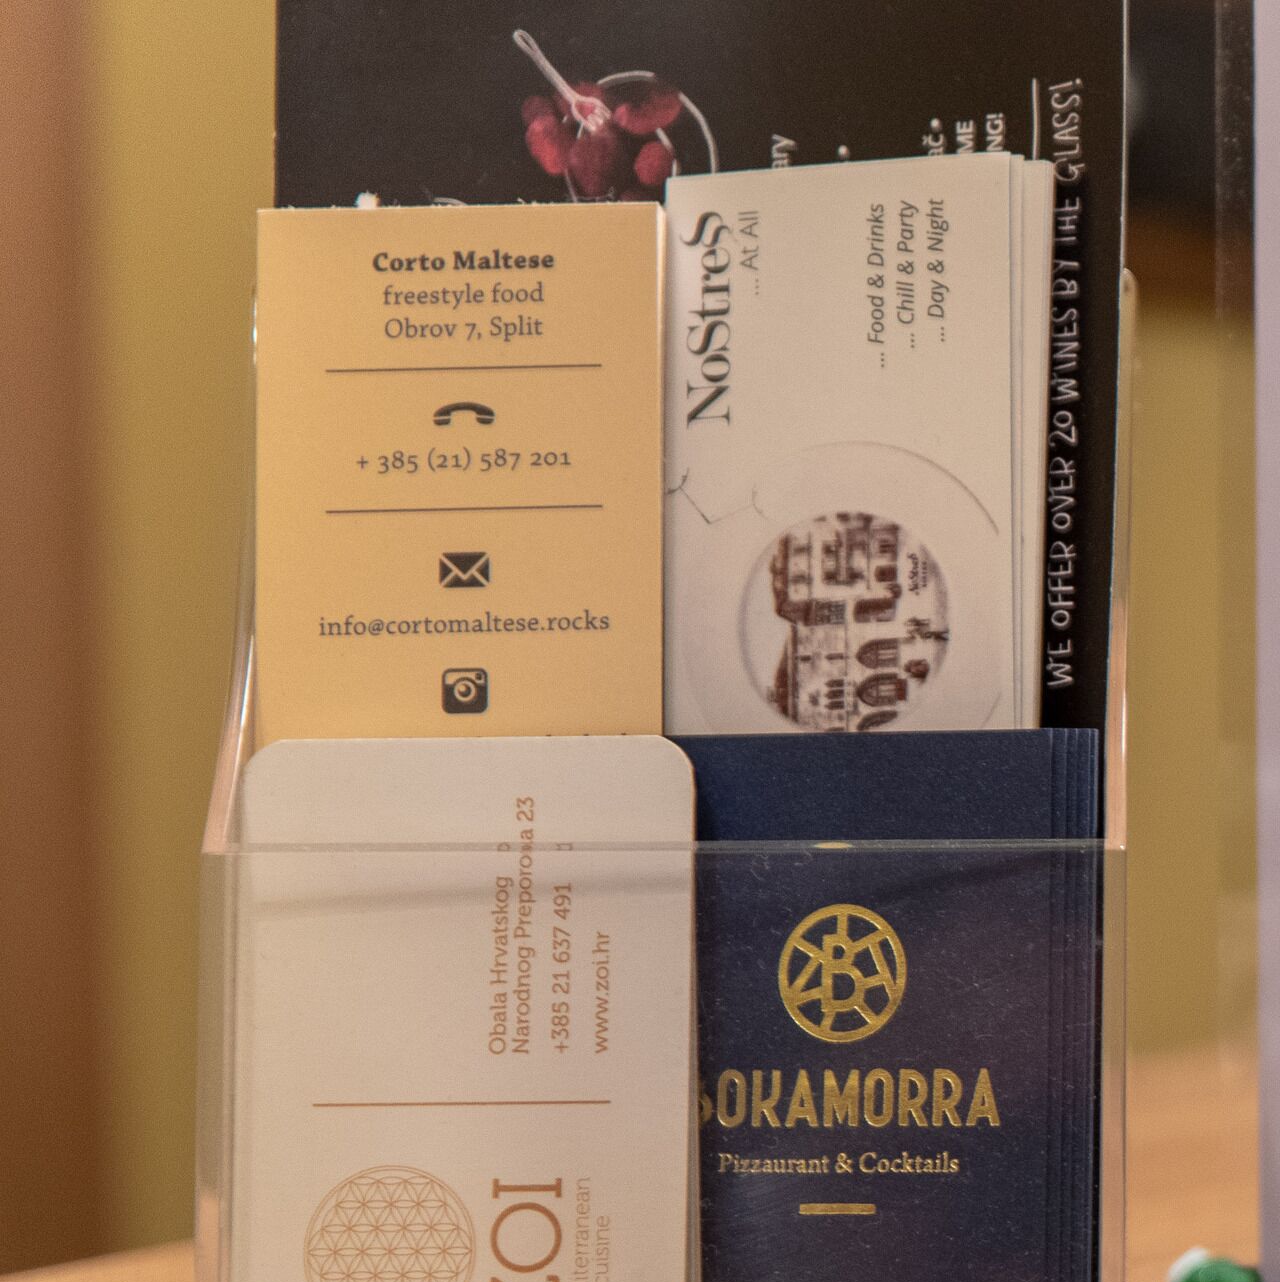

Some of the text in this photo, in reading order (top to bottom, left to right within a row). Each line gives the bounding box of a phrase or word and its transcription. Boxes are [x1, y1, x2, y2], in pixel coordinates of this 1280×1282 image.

[372, 249, 555, 272] Corto Maltese
[738, 210, 759, 271] At All
[866, 203, 885, 344] Food & Drinks
[896, 200, 919, 325] Chill & Party
[927, 198, 950, 319] Day & Night
[383, 281, 544, 310] freestyle food
[384, 315, 544, 342] Obrov 7, Split
[1046, 77, 1085, 689] WE OFFER OVER 20 WINES BY THE GLASS!
[377, 447, 571, 474] 385 (21) 587 201
[319, 608, 610, 637] info@cortomaltese.rocks
[517, 797, 534, 822] 23
[488, 876, 513, 1055] Obala Hrvatskog
[512, 946, 536, 1054] Narodnog
[551, 883, 571, 1053] +385 21 637 491
[592, 931, 610, 1054] www.zoi.hr
[718, 1152, 959, 1174] Pizzaurant & Cocktails
